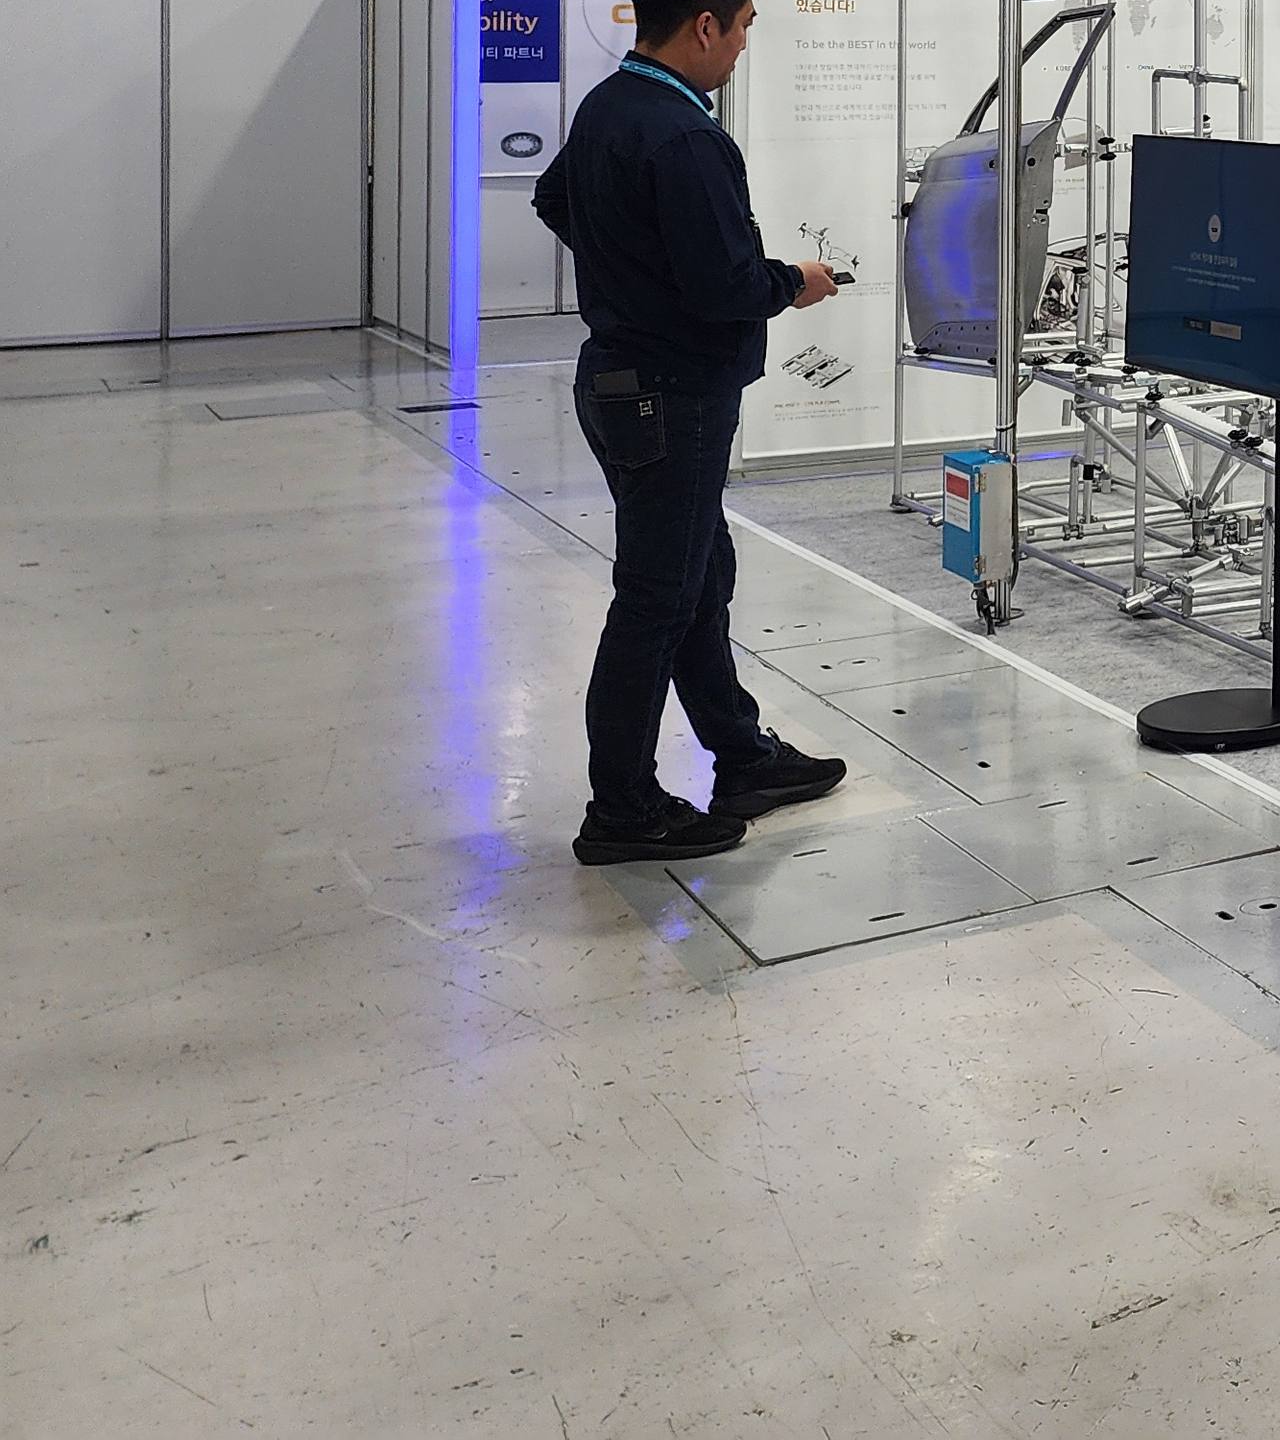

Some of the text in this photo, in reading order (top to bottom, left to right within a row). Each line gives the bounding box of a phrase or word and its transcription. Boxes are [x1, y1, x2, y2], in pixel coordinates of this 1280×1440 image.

[796, 0, 855, 13] 있습니다!
[795, 40, 809, 49] To
[812, 40, 825, 49] be
[828, 40, 845, 49] the
[848, 40, 874, 49] BEST
[876, 40, 886, 49] in
[908, 40, 936, 50] world
[503, 46, 543, 60] 파트너
